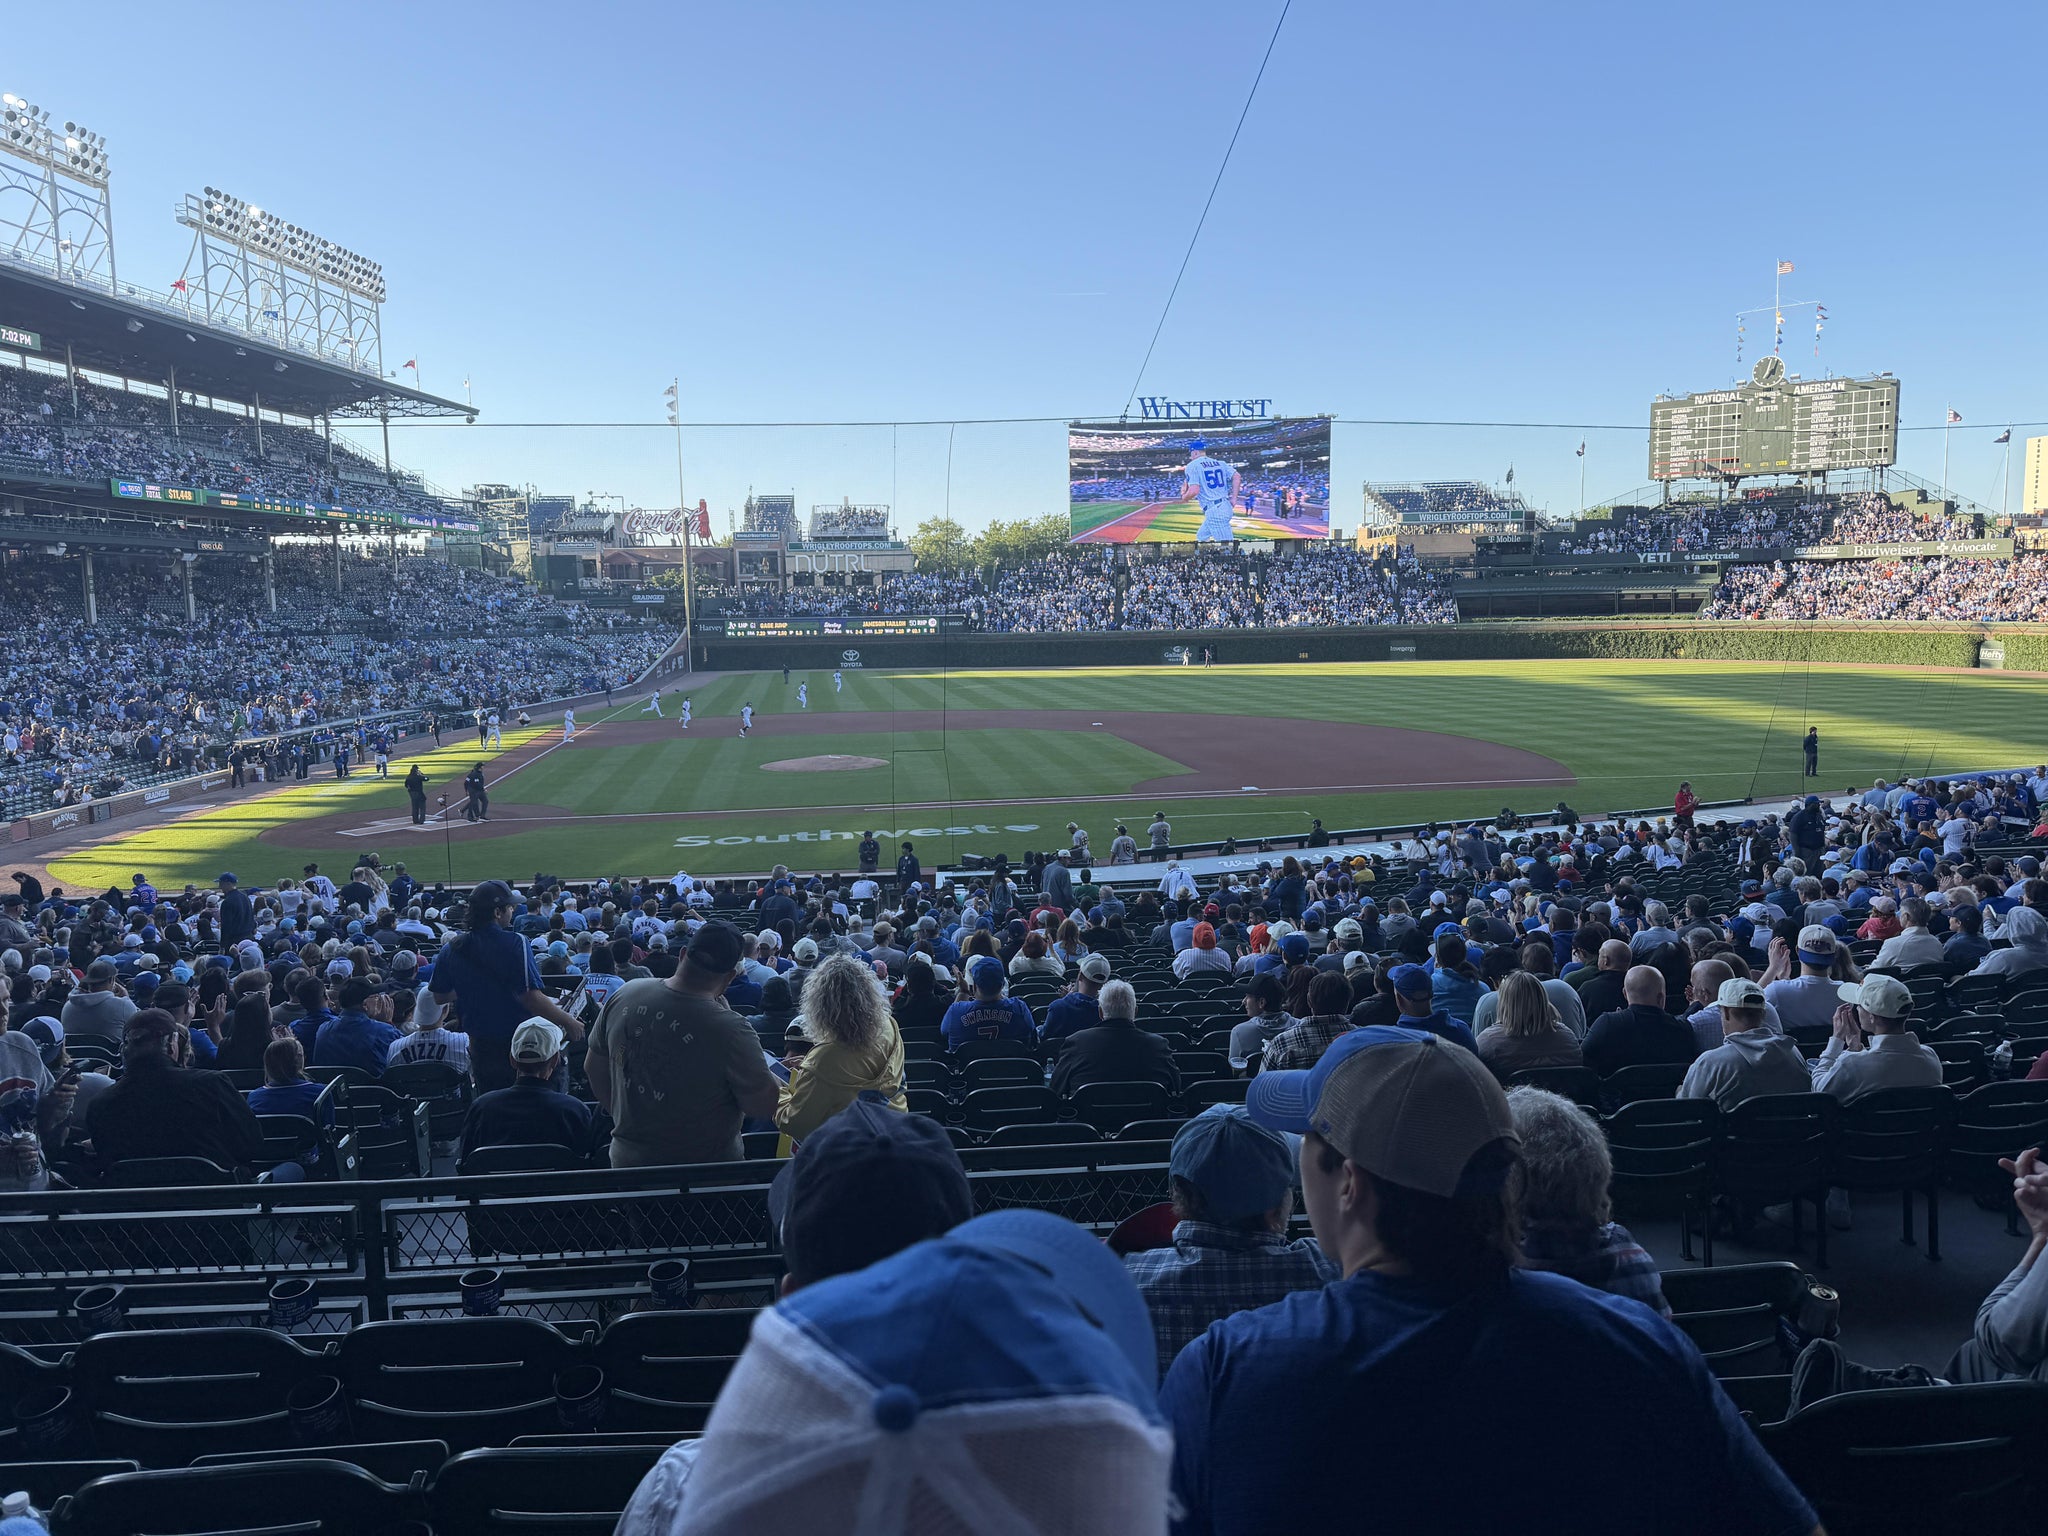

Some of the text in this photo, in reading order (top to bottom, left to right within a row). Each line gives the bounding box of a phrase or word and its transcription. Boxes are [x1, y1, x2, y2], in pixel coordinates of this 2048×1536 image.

[0, 328, 32, 346] 7:02 PM
[1794, 381, 1845, 395] AMERICAN
[1694, 392, 1743, 404] NATIONAL
[1137, 396, 1273, 420] WINTRUST
[1204, 469, 1224, 490] 50
[145, 491, 162, 499] TOTAL
[168, 488, 192, 501] $11,448
[622, 507, 705, 537] Coca-Cola
[1419, 512, 1508, 522] WRIGLEYROOFTOPS.COM
[802, 542, 892, 550] WRIGLEYROOFTOPS.COM
[1794, 546, 1839, 555] GRAINGER
[1854, 546, 1924, 556] Budweiser
[1950, 542, 1998, 553] Advocate
[1636, 552, 1672, 563] YETI
[1691, 552, 1740, 562] tastytrade
[700, 624, 724, 636] Harvey
[1980, 650, 2004, 660] Hefty
[144, 788, 170, 800] GRAINGER
[52, 813, 80, 828] MARQUEE
[672, 824, 1001, 848] Southwest
[622, 1004, 694, 1044] SMOKE
[960, 1009, 1013, 1027] SWANSON
[401, 1042, 447, 1064] RIZZO
